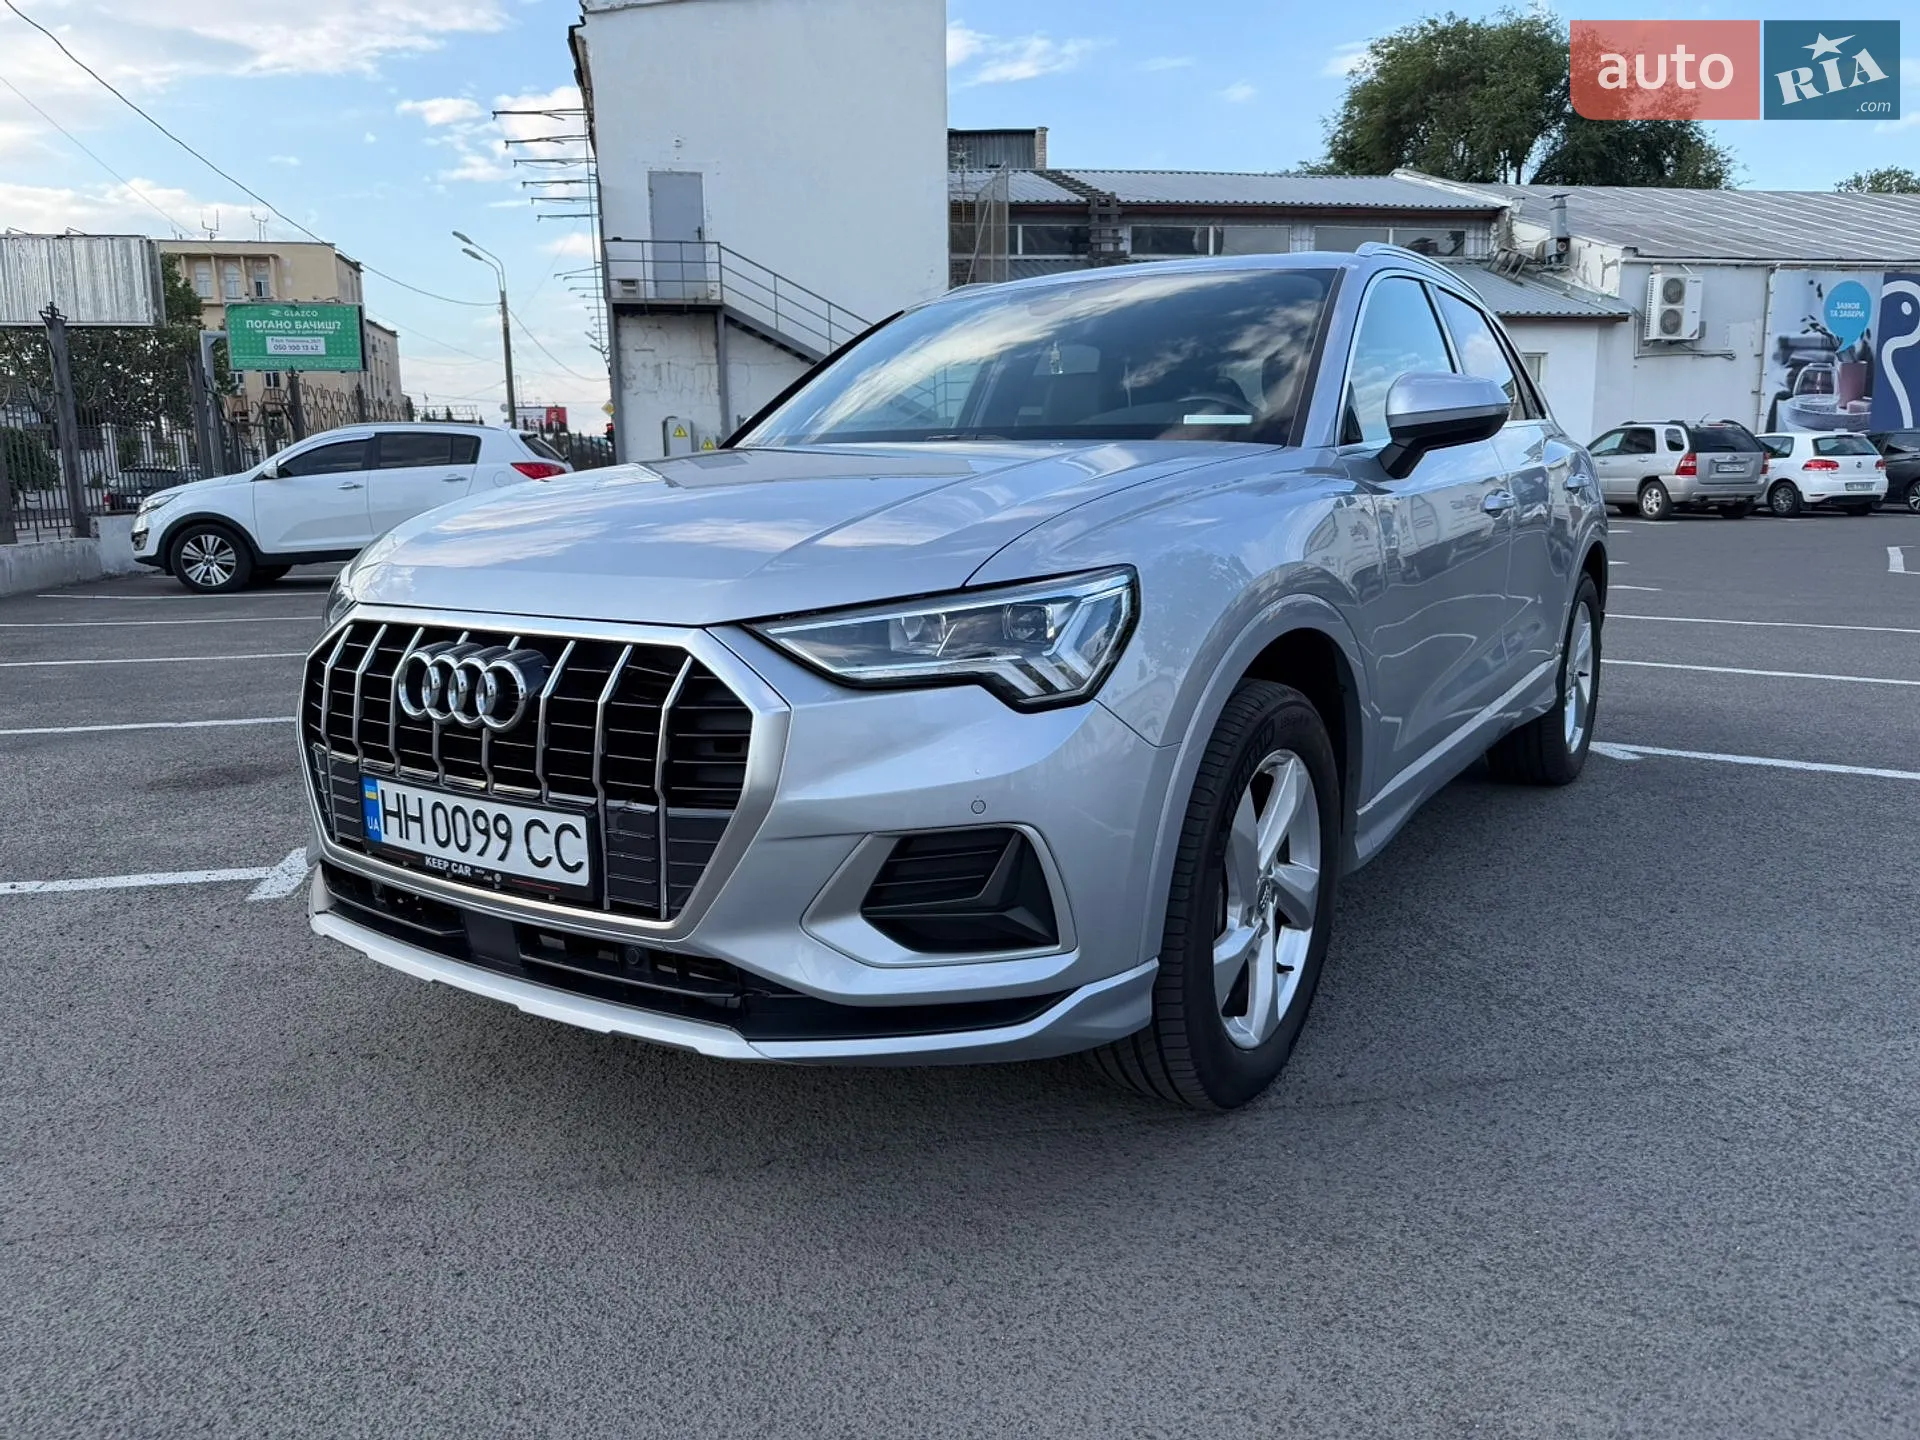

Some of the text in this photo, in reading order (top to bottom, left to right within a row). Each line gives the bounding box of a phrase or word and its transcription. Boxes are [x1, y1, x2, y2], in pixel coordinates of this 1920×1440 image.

[246, 319, 342, 329] ПОГАНО БАЧИШ?
[366, 816, 380, 832] UA
[425, 855, 449, 871] KEEP
[451, 861, 472, 877] CAR
